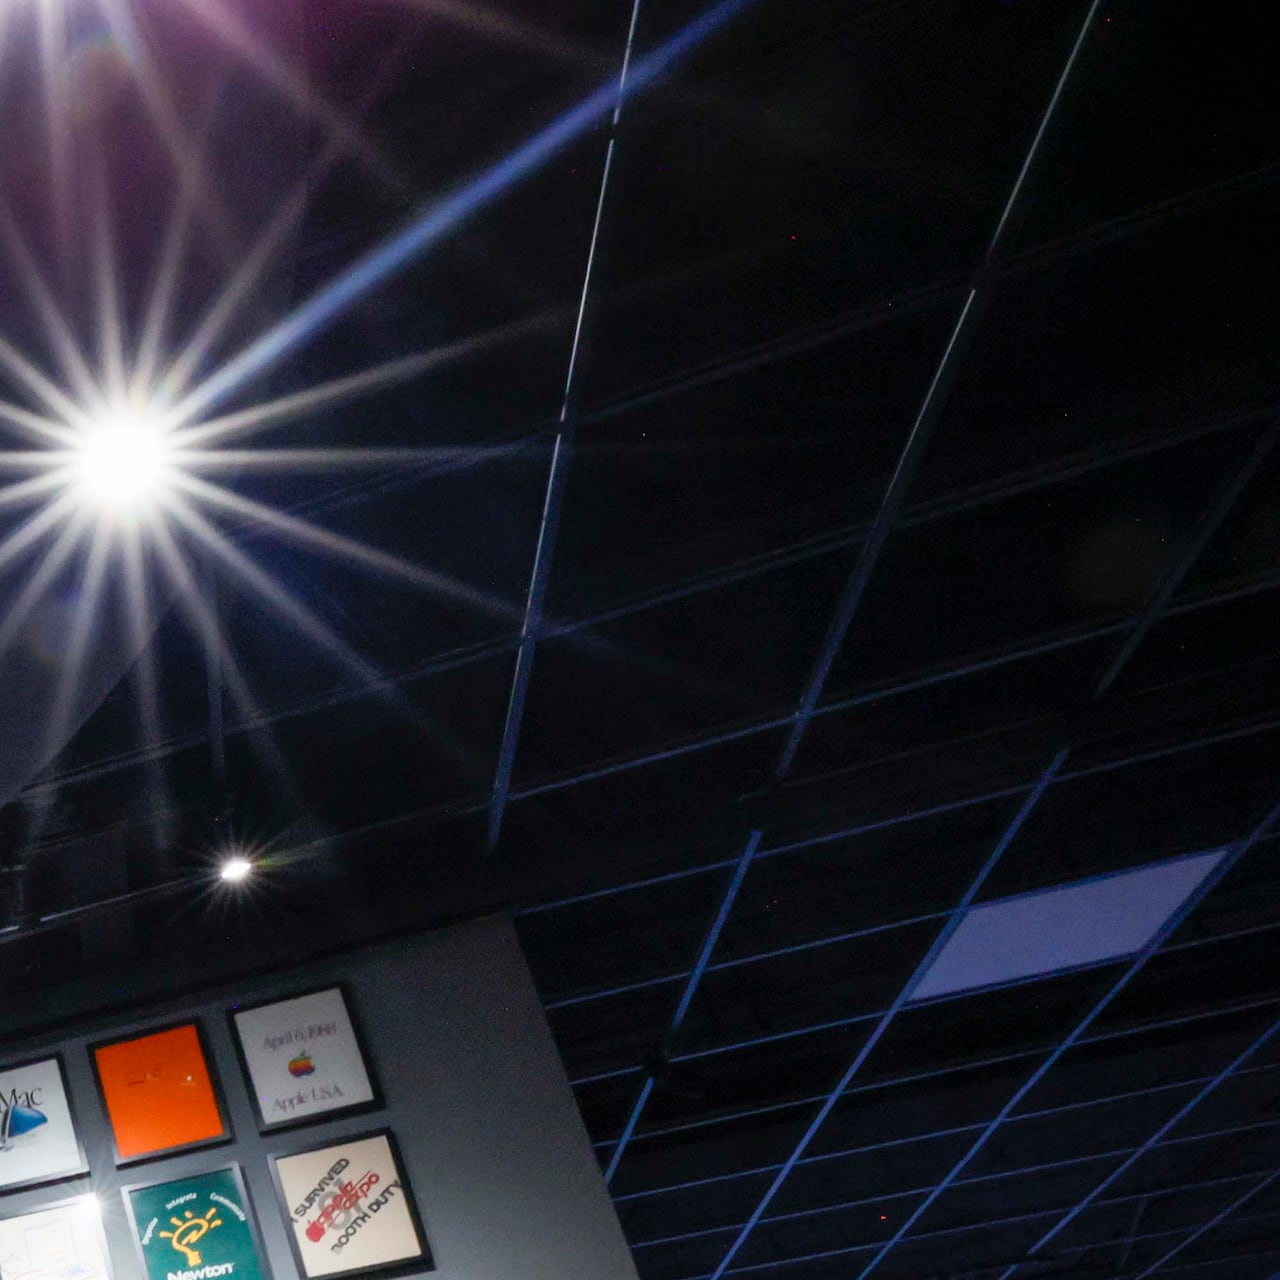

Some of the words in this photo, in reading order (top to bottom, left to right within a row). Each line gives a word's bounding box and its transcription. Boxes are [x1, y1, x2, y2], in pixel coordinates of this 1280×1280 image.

[293, 1157, 350, 1220] SURVIVED
[331, 1219, 369, 1254] BOOTH
[365, 1179, 402, 1219] DUTY
